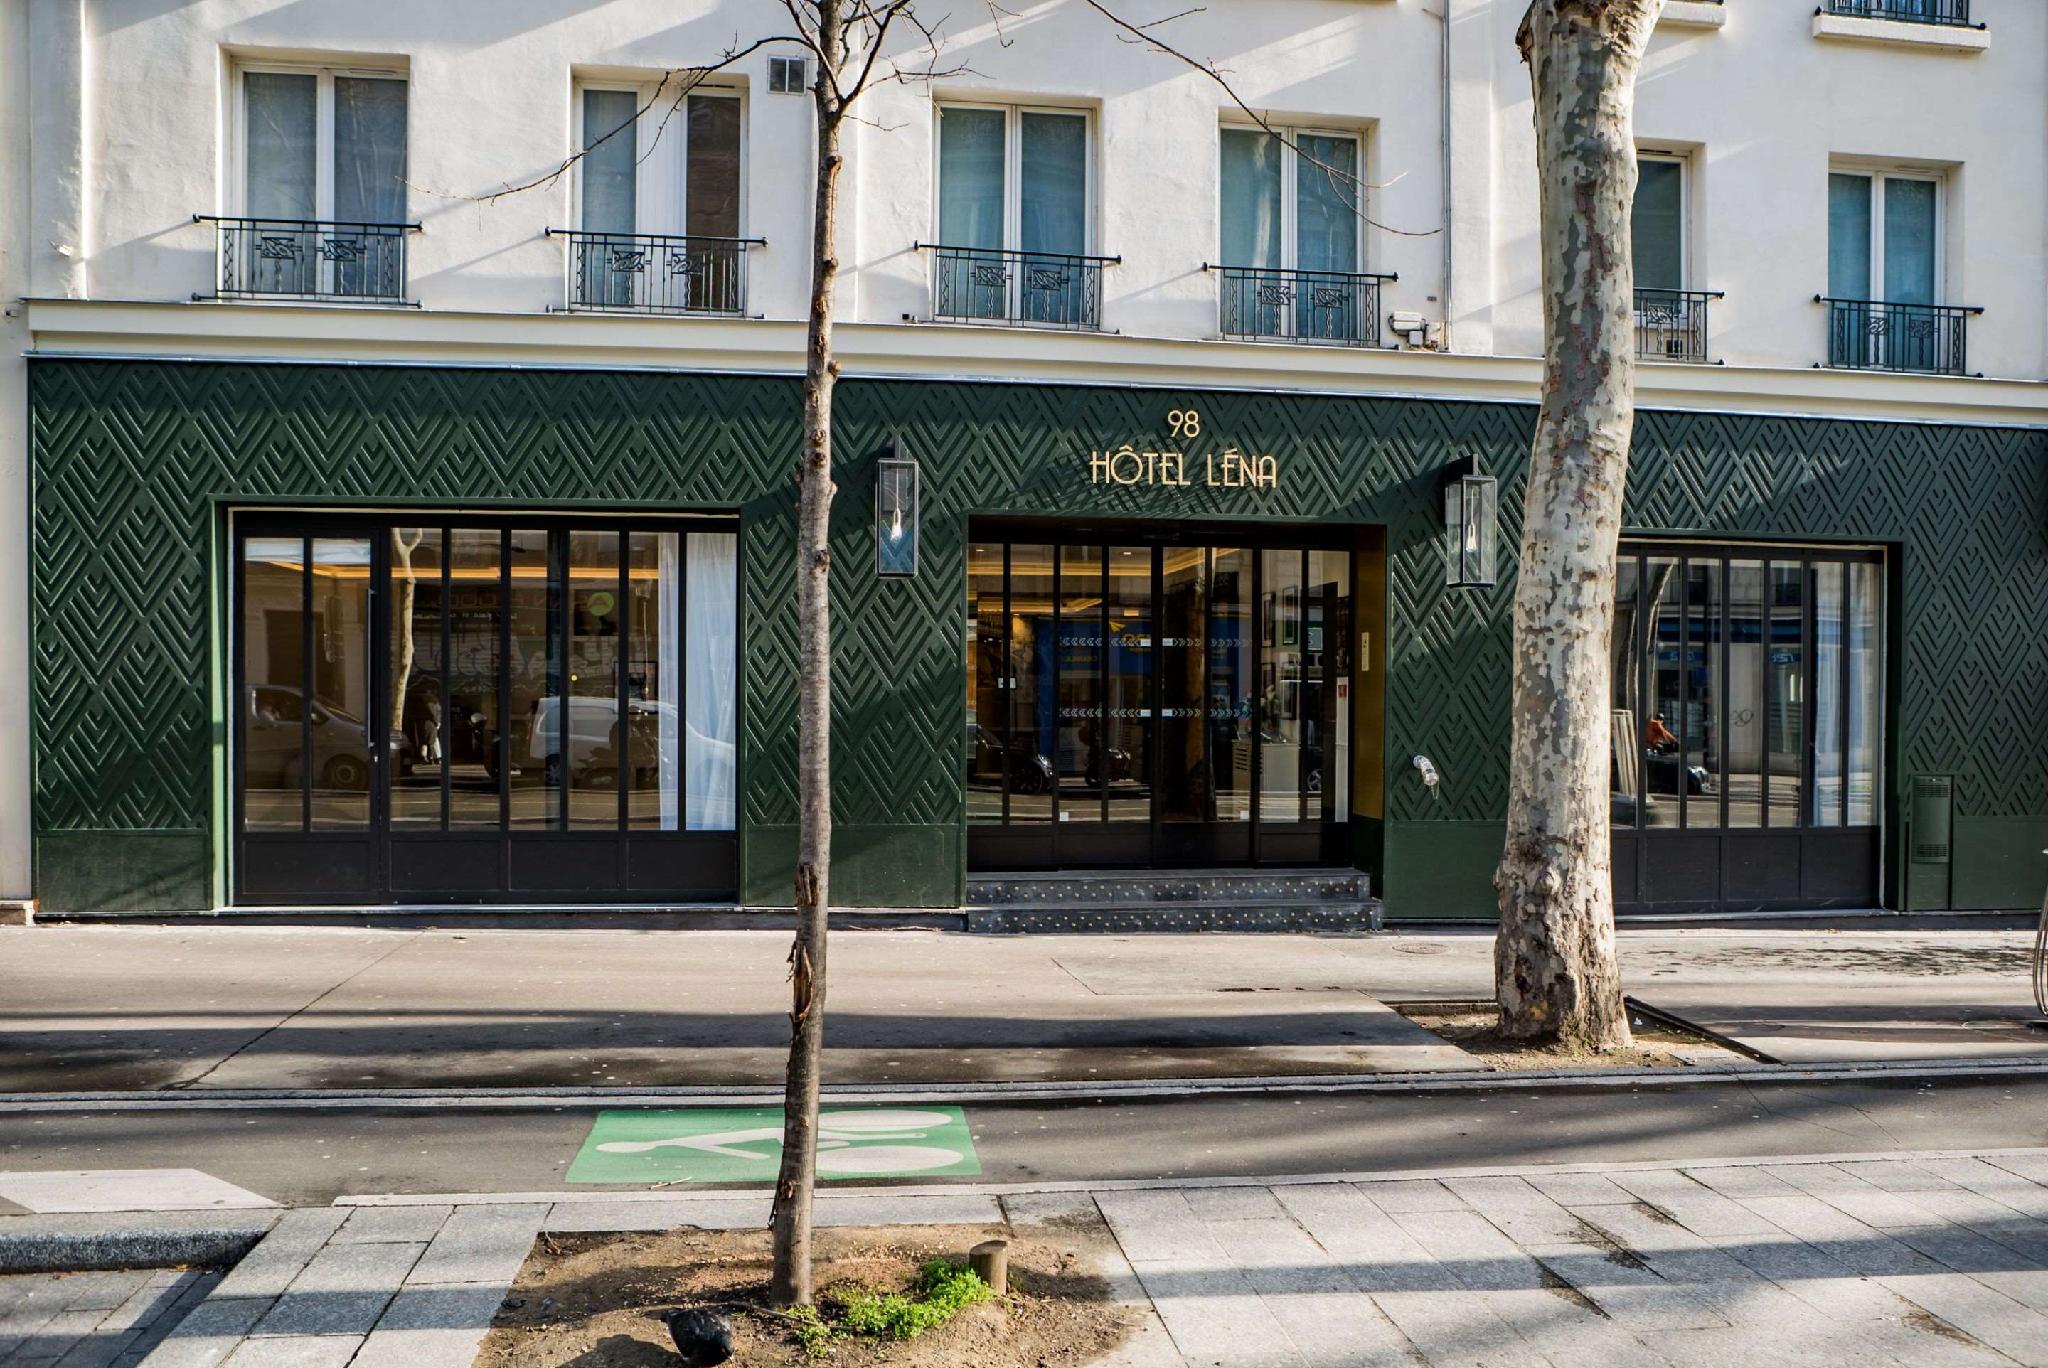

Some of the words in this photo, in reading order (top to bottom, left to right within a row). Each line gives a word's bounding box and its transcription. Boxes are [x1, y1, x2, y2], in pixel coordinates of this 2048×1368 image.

[1167, 410, 1200, 438] 98
[1089, 445, 1191, 486] HÔTEL
[1207, 448, 1277, 488] LÉNA
